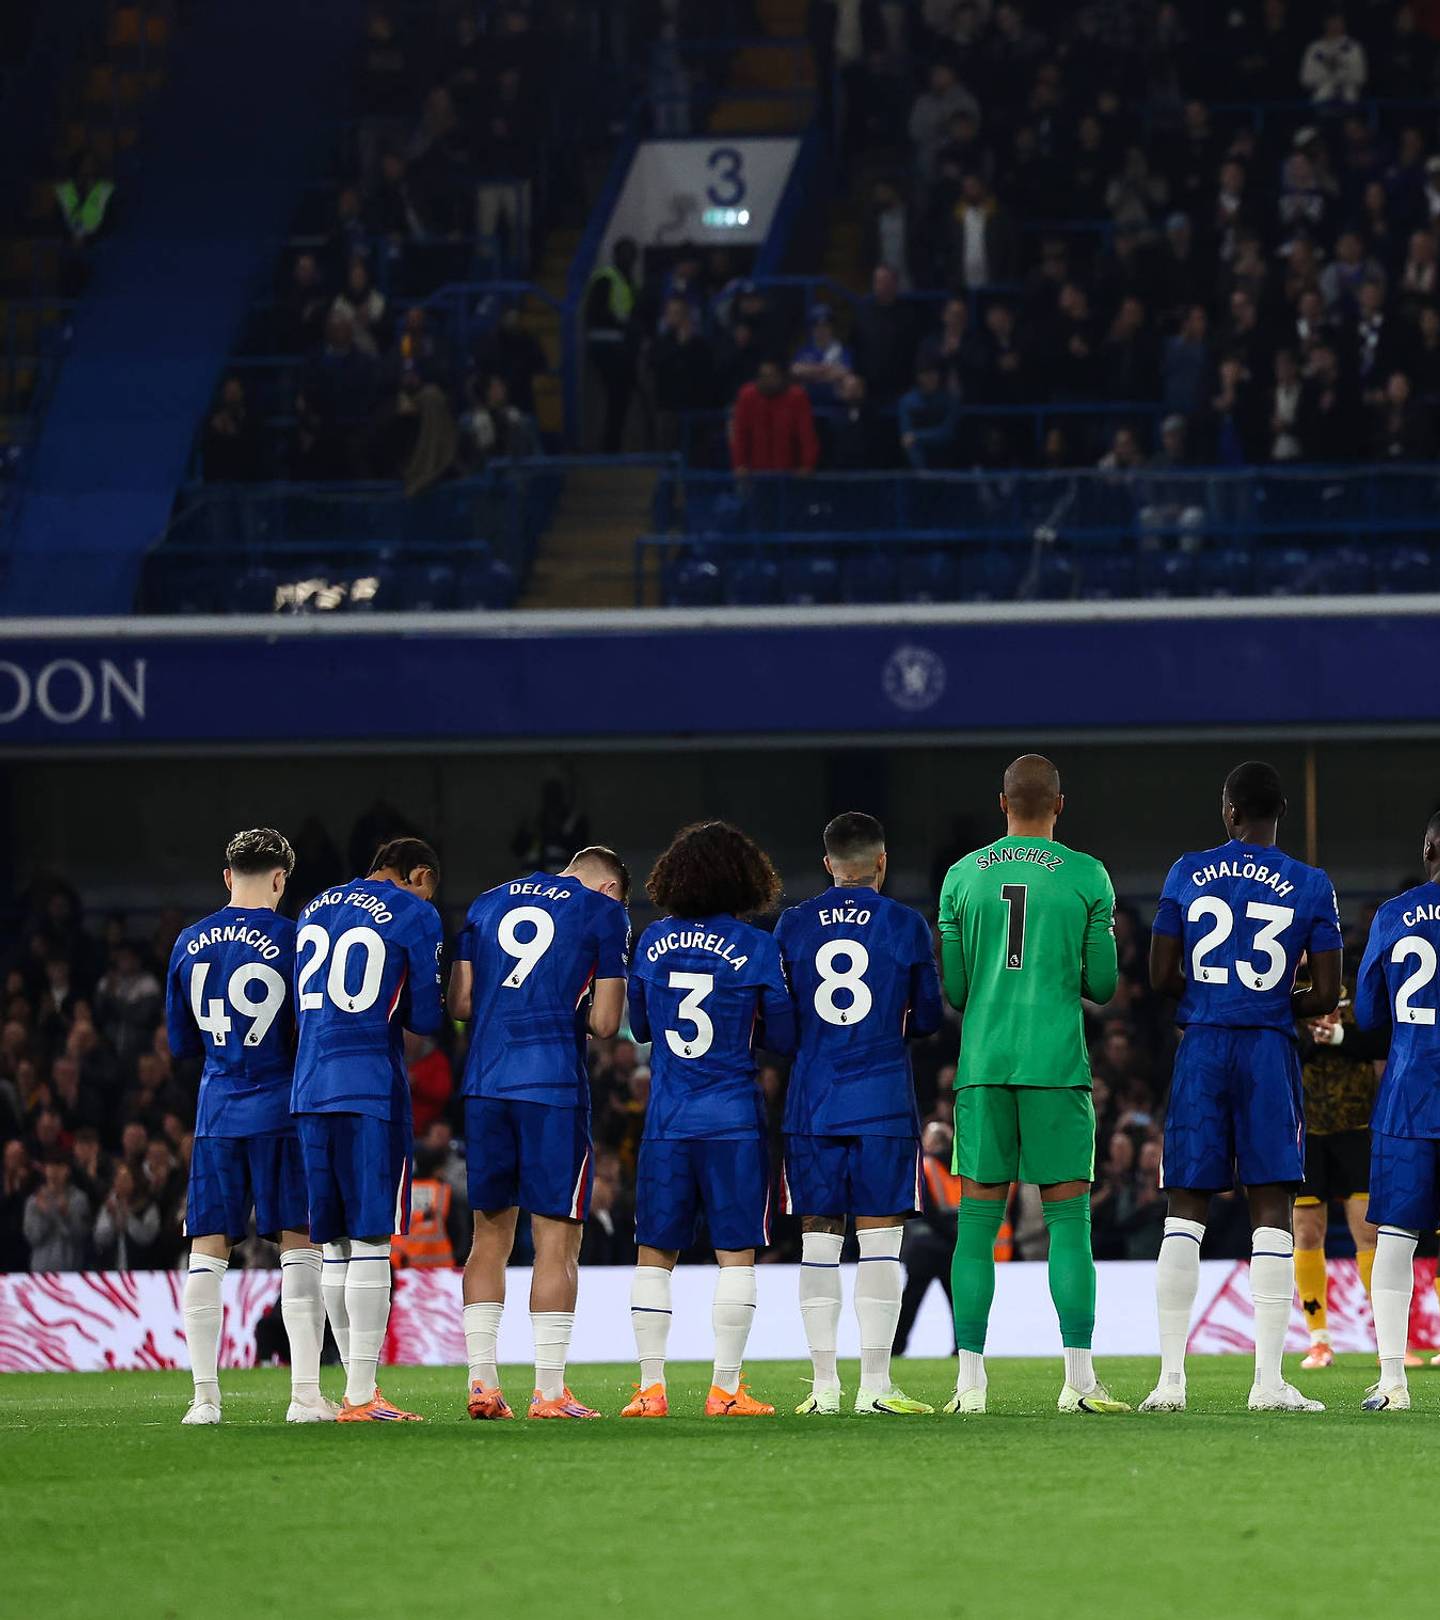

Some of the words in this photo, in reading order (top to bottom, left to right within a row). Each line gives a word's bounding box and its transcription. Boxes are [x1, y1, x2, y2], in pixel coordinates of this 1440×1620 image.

[706, 147, 747, 207] 3
[975, 845, 1065, 872] SÁNCHEZ
[1192, 861, 1294, 898] CHALOBAH
[304, 889, 343, 919] JOÃO
[343, 892, 393, 924] PEDRO
[509, 883, 571, 901] DELAP
[818, 908, 871, 926] ENZO
[187, 925, 280, 961] GARNACHO
[497, 906, 555, 989] 9
[646, 931, 749, 972] CUCURELLA
[1000, 884, 1028, 970] 1
[1187, 896, 1295, 992] 23
[296, 923, 387, 1014] 20
[814, 939, 872, 1026] 8
[190, 962, 286, 1047] 49
[664, 971, 714, 1059] 3
